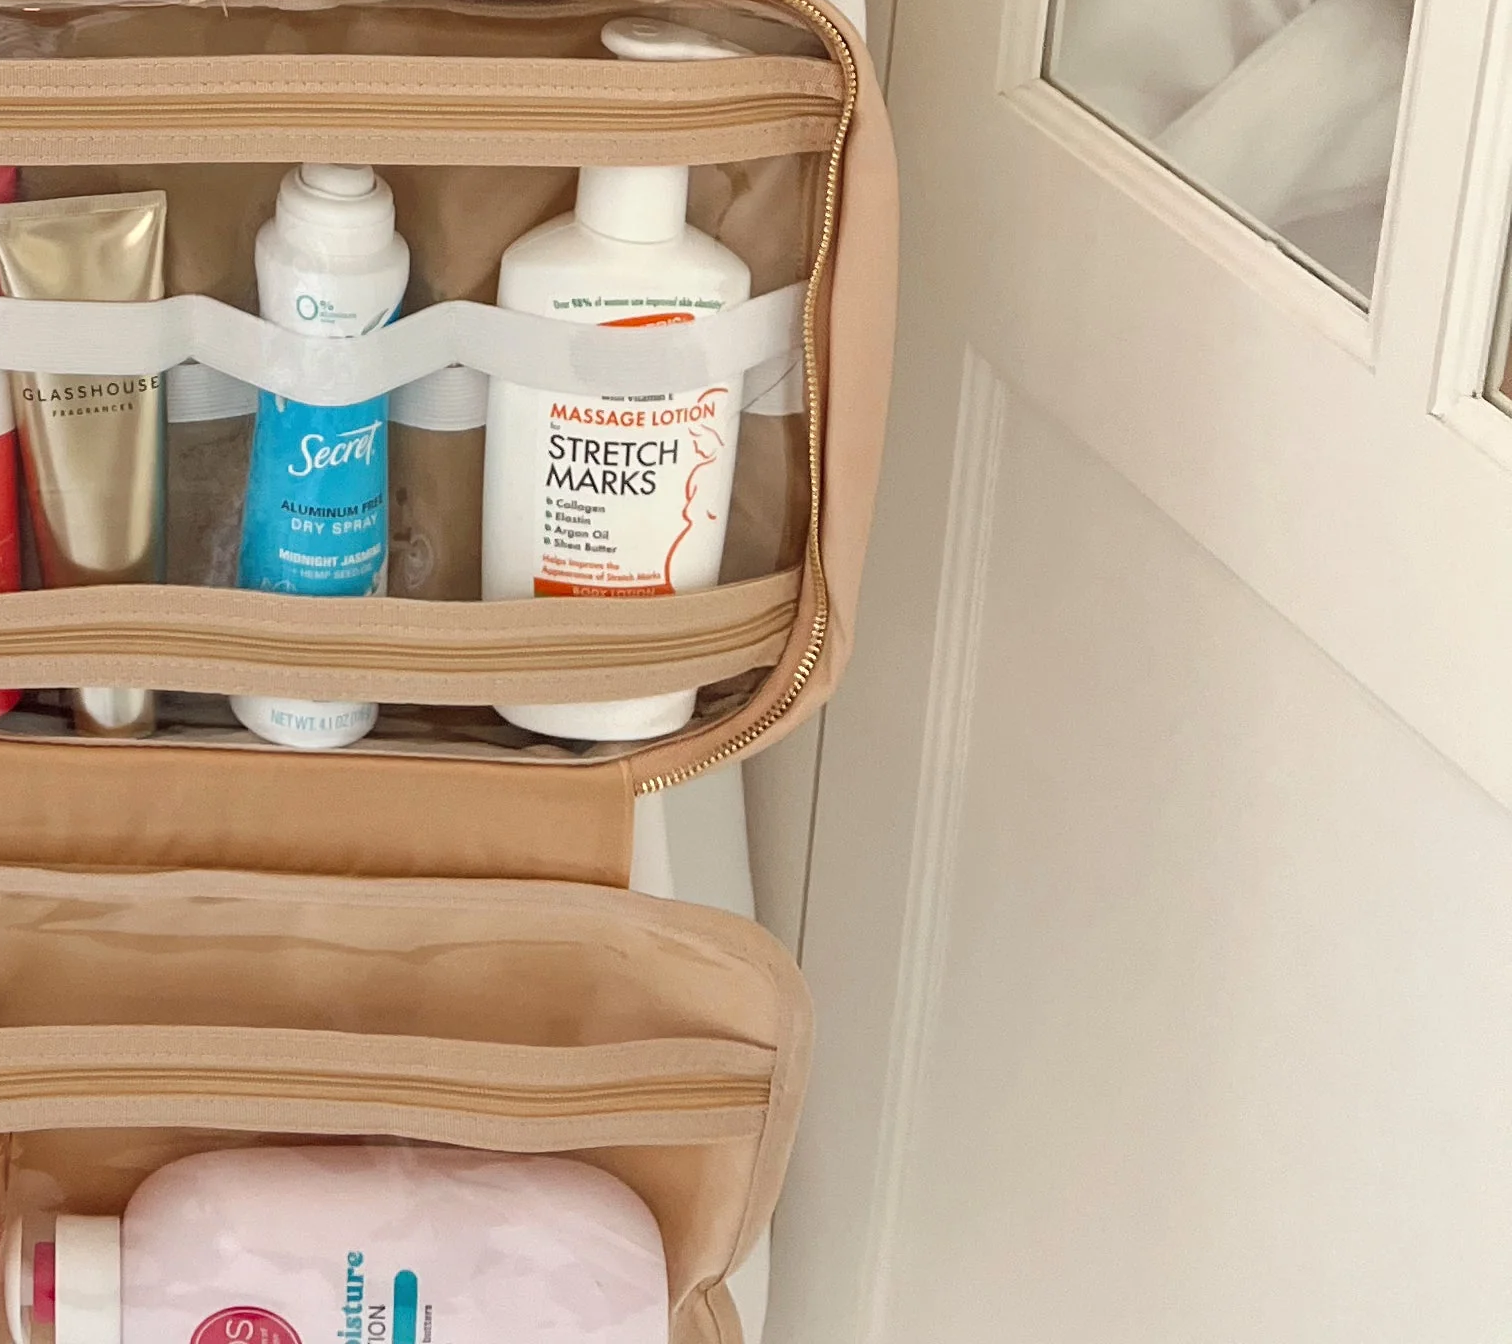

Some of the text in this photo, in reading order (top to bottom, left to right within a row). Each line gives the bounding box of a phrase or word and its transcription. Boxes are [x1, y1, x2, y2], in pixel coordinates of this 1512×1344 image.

[23, 375, 160, 402] GLASSHOUSE
[52, 403, 134, 417] FRAGRANCES
[550, 402, 716, 427] MASSAGE LOTION
[288, 419, 383, 477] Secret
[548, 434, 679, 467] STRETCH
[546, 462, 657, 496] MARKS
[280, 499, 359, 518] ALUMINUM
[556, 498, 606, 514] Collagen
[291, 513, 378, 535] DRY SPRAY
[555, 512, 591, 525] Elastin
[592, 530, 609, 540] Oil
[554, 538, 617, 554] Shea Butter
[279, 548, 339, 568] MIDNIGHT
